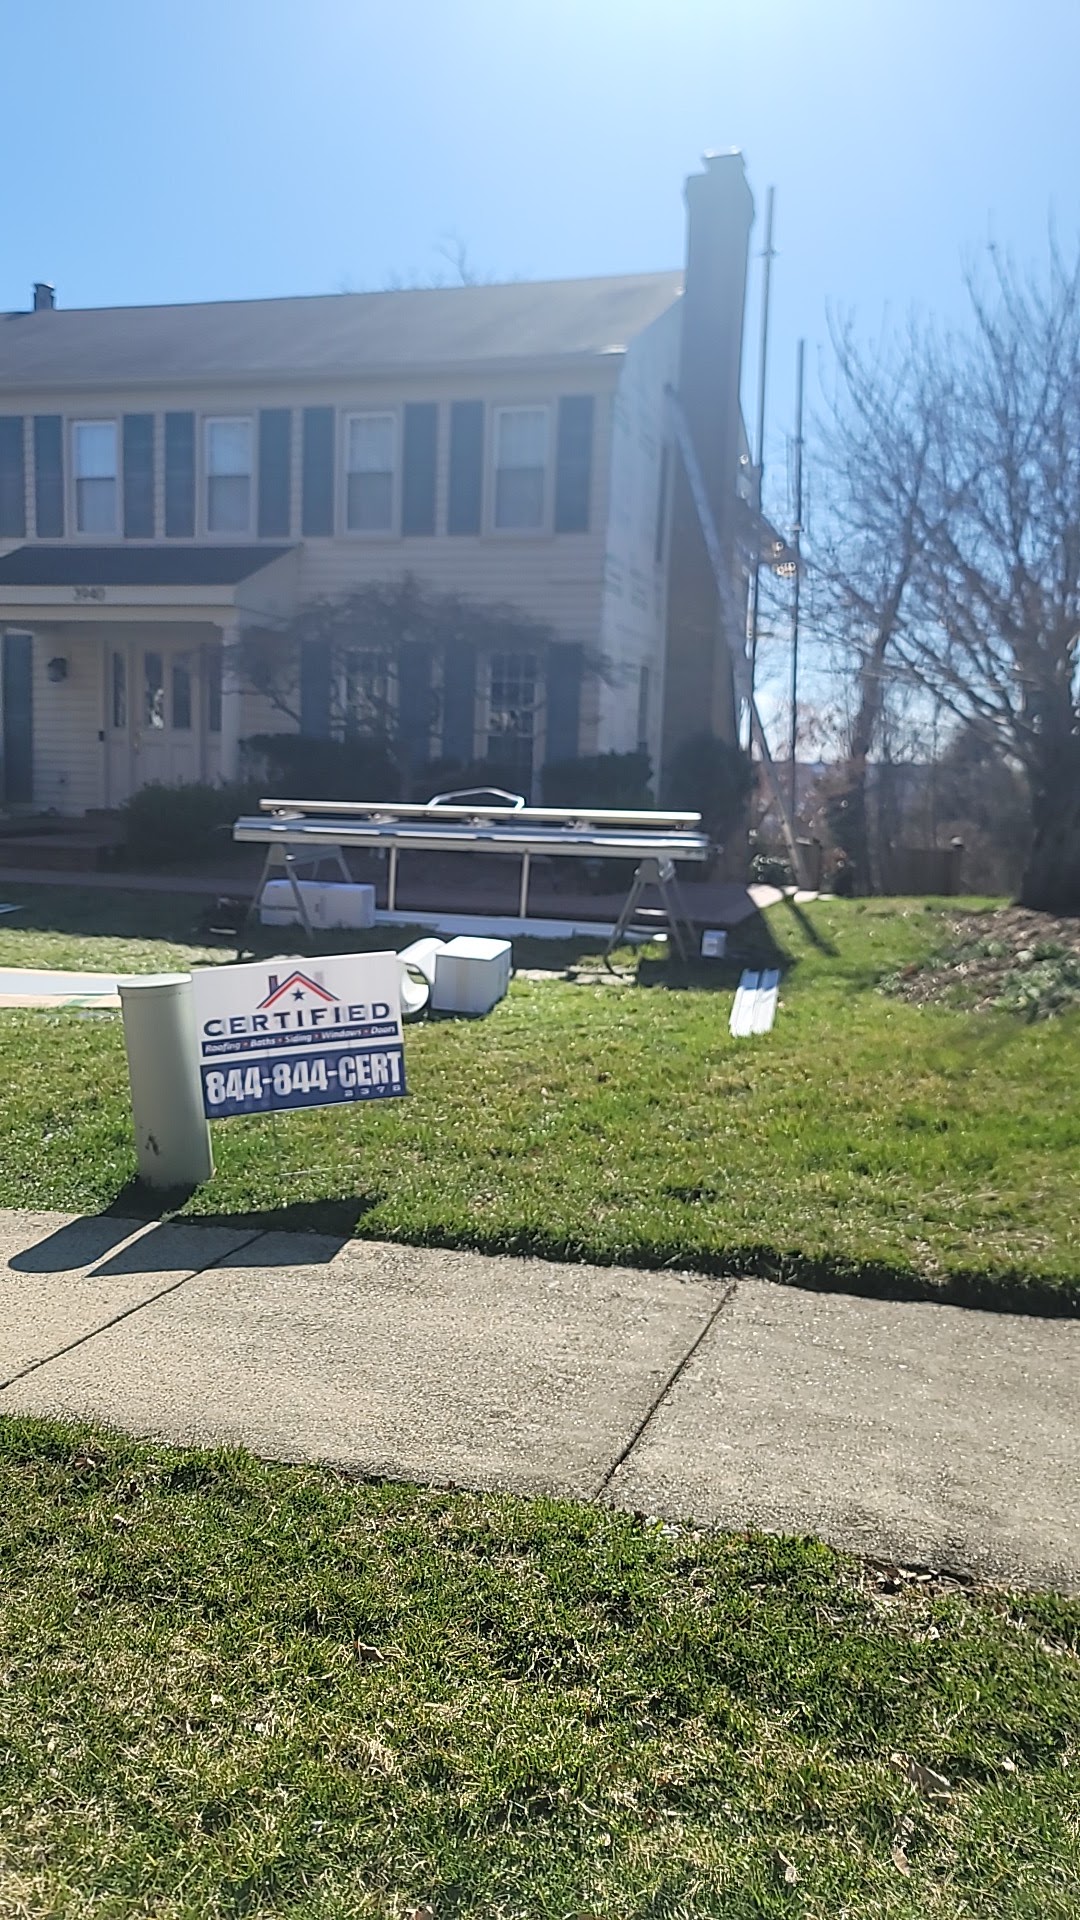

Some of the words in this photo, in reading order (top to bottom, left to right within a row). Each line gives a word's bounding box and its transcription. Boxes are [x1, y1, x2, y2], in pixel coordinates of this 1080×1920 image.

[203, 1003, 390, 1036] CERTIFIED
[205, 1042, 241, 1054] Roofing
[250, 1038, 276, 1048] Baths
[284, 1033, 312, 1044] Siding
[321, 1028, 362, 1040] Windows
[370, 1025, 396, 1035] Doors
[205, 1051, 401, 1104] 844-844-CERT
